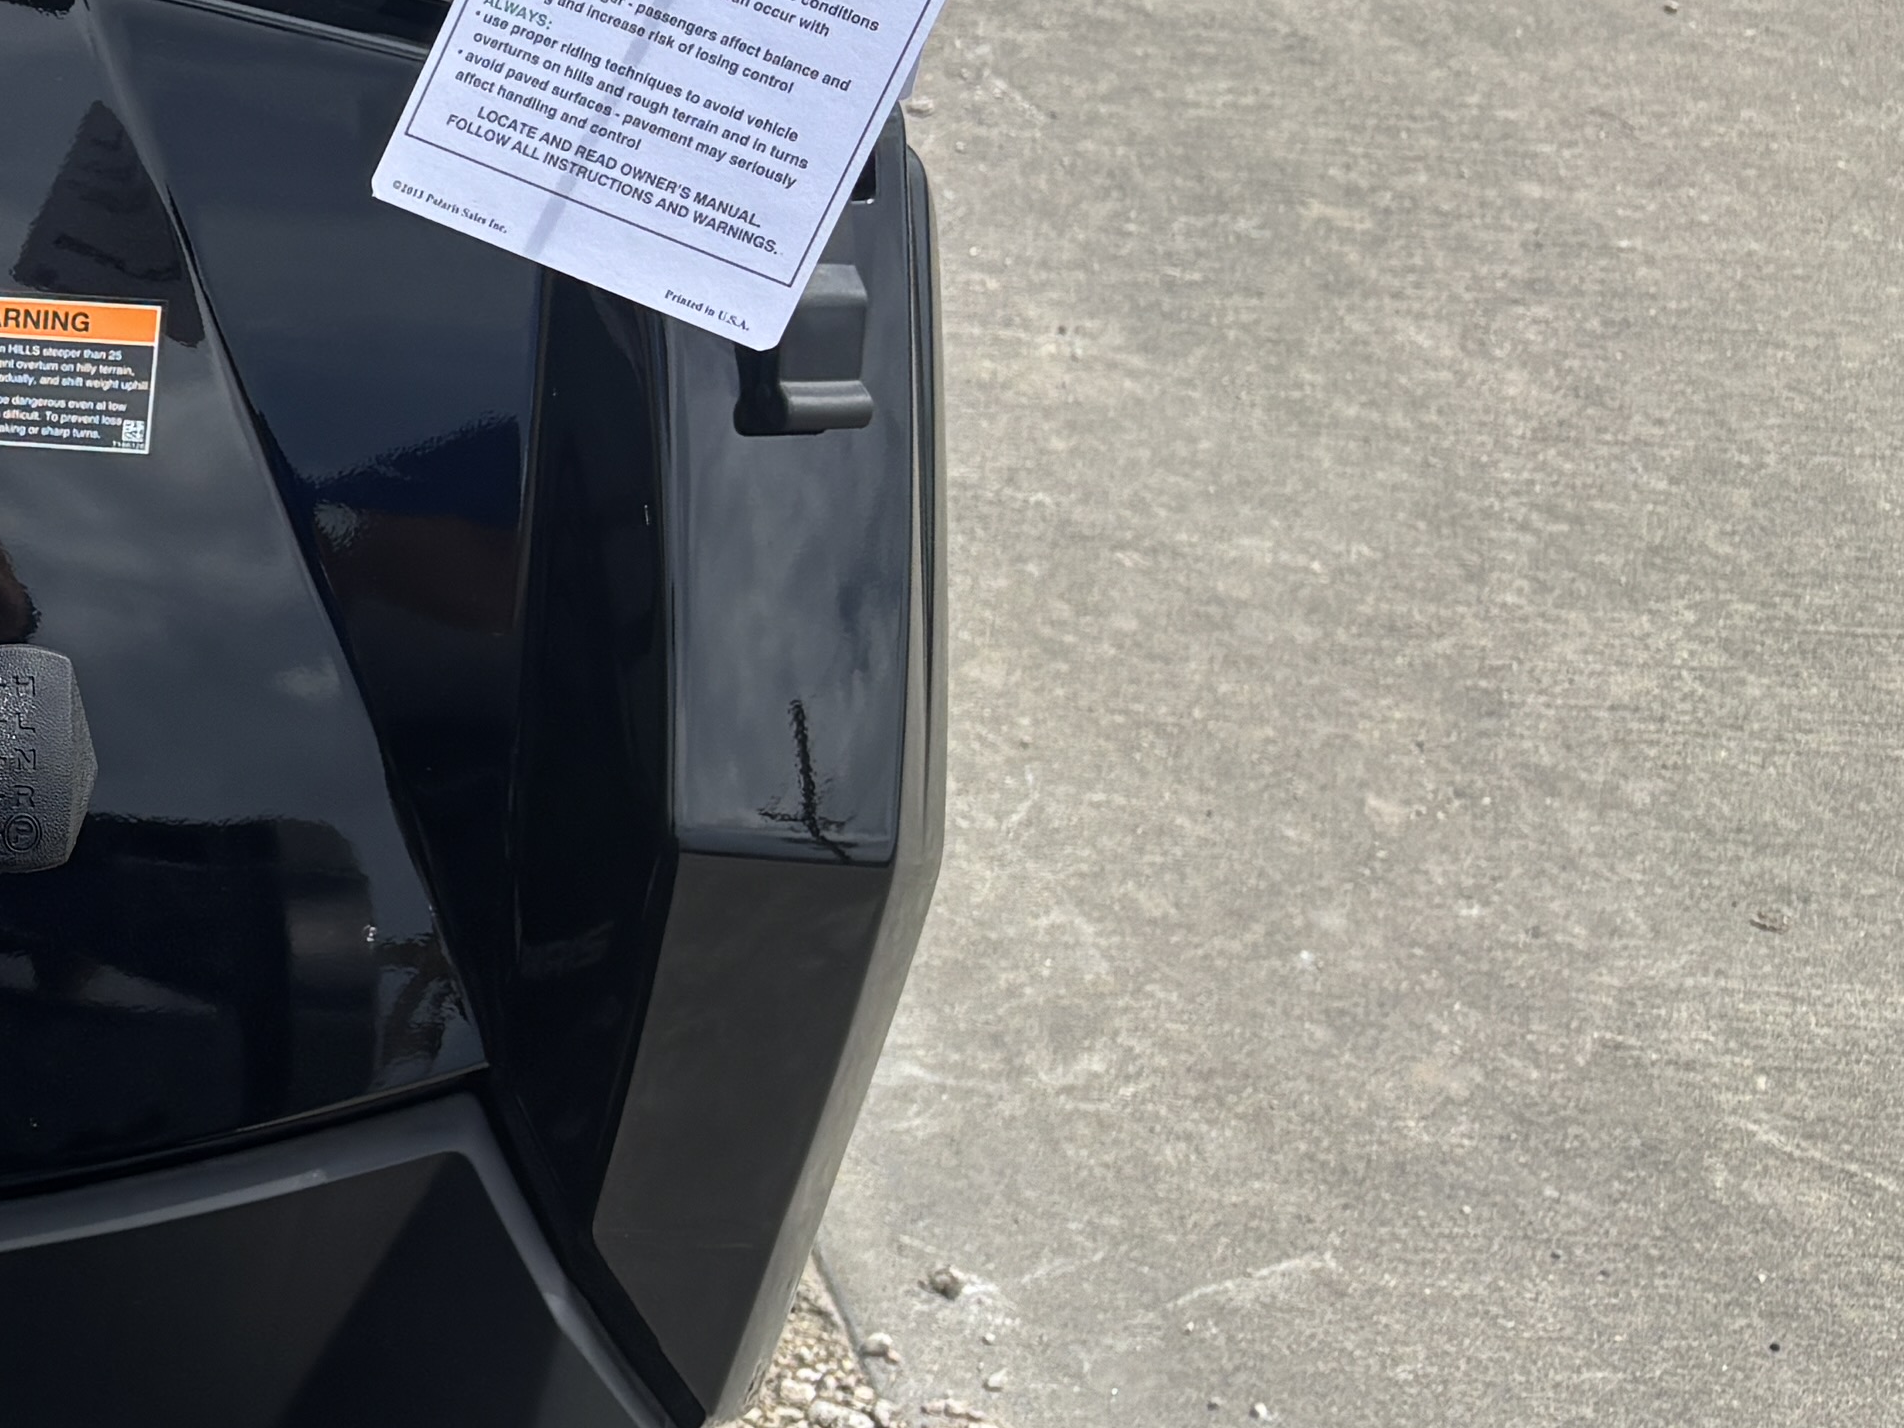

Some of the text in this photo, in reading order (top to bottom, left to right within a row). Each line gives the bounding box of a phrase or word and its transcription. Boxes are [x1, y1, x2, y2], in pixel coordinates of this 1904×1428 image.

[444, 113, 782, 255] FOLLOW ALL INSTRUCTIONS AND WARNINGS.
[475, 105, 765, 228] LOCATE AND READ OWNER'S MANUAL.
